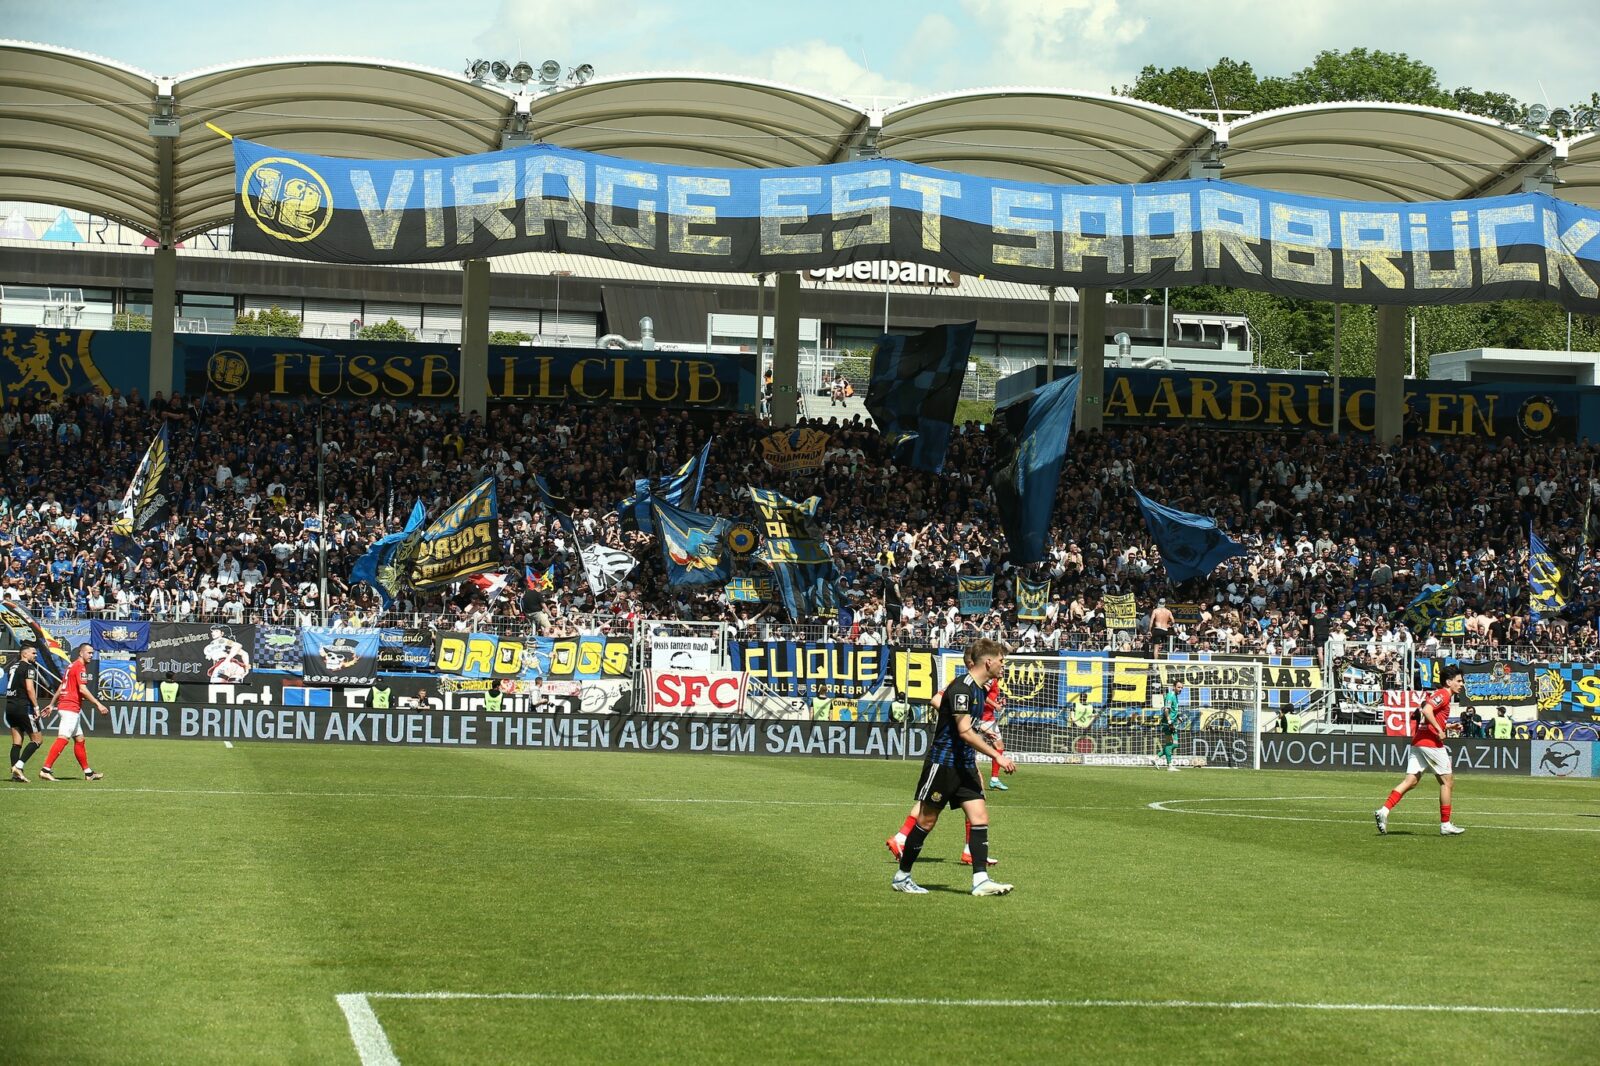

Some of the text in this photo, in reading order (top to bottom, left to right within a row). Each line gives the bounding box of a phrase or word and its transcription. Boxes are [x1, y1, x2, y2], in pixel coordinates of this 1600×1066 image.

[350, 155, 732, 257] VIRAGE
[759, 168, 962, 256] EST
[270, 353, 721, 403] FUSSBLLCLUB
[1103, 376, 1499, 436] AARBRÜCEN
[139, 656, 202, 674] Luder
[745, 647, 879, 681] CLIQUE
[654, 674, 739, 708] SFC
[747, 683, 794, 692] ANAILLE
[110, 705, 169, 737] WIR
[181, 707, 316, 740] BRINGEN
[323, 711, 478, 745] AKTUELLE
[486, 716, 610, 749] THEMEN
[618, 720, 680, 751] AUS
[690, 722, 756, 753] DEM
[766, 724, 928, 757] SAARLAND
[1192, 738, 1248, 763] DAS
